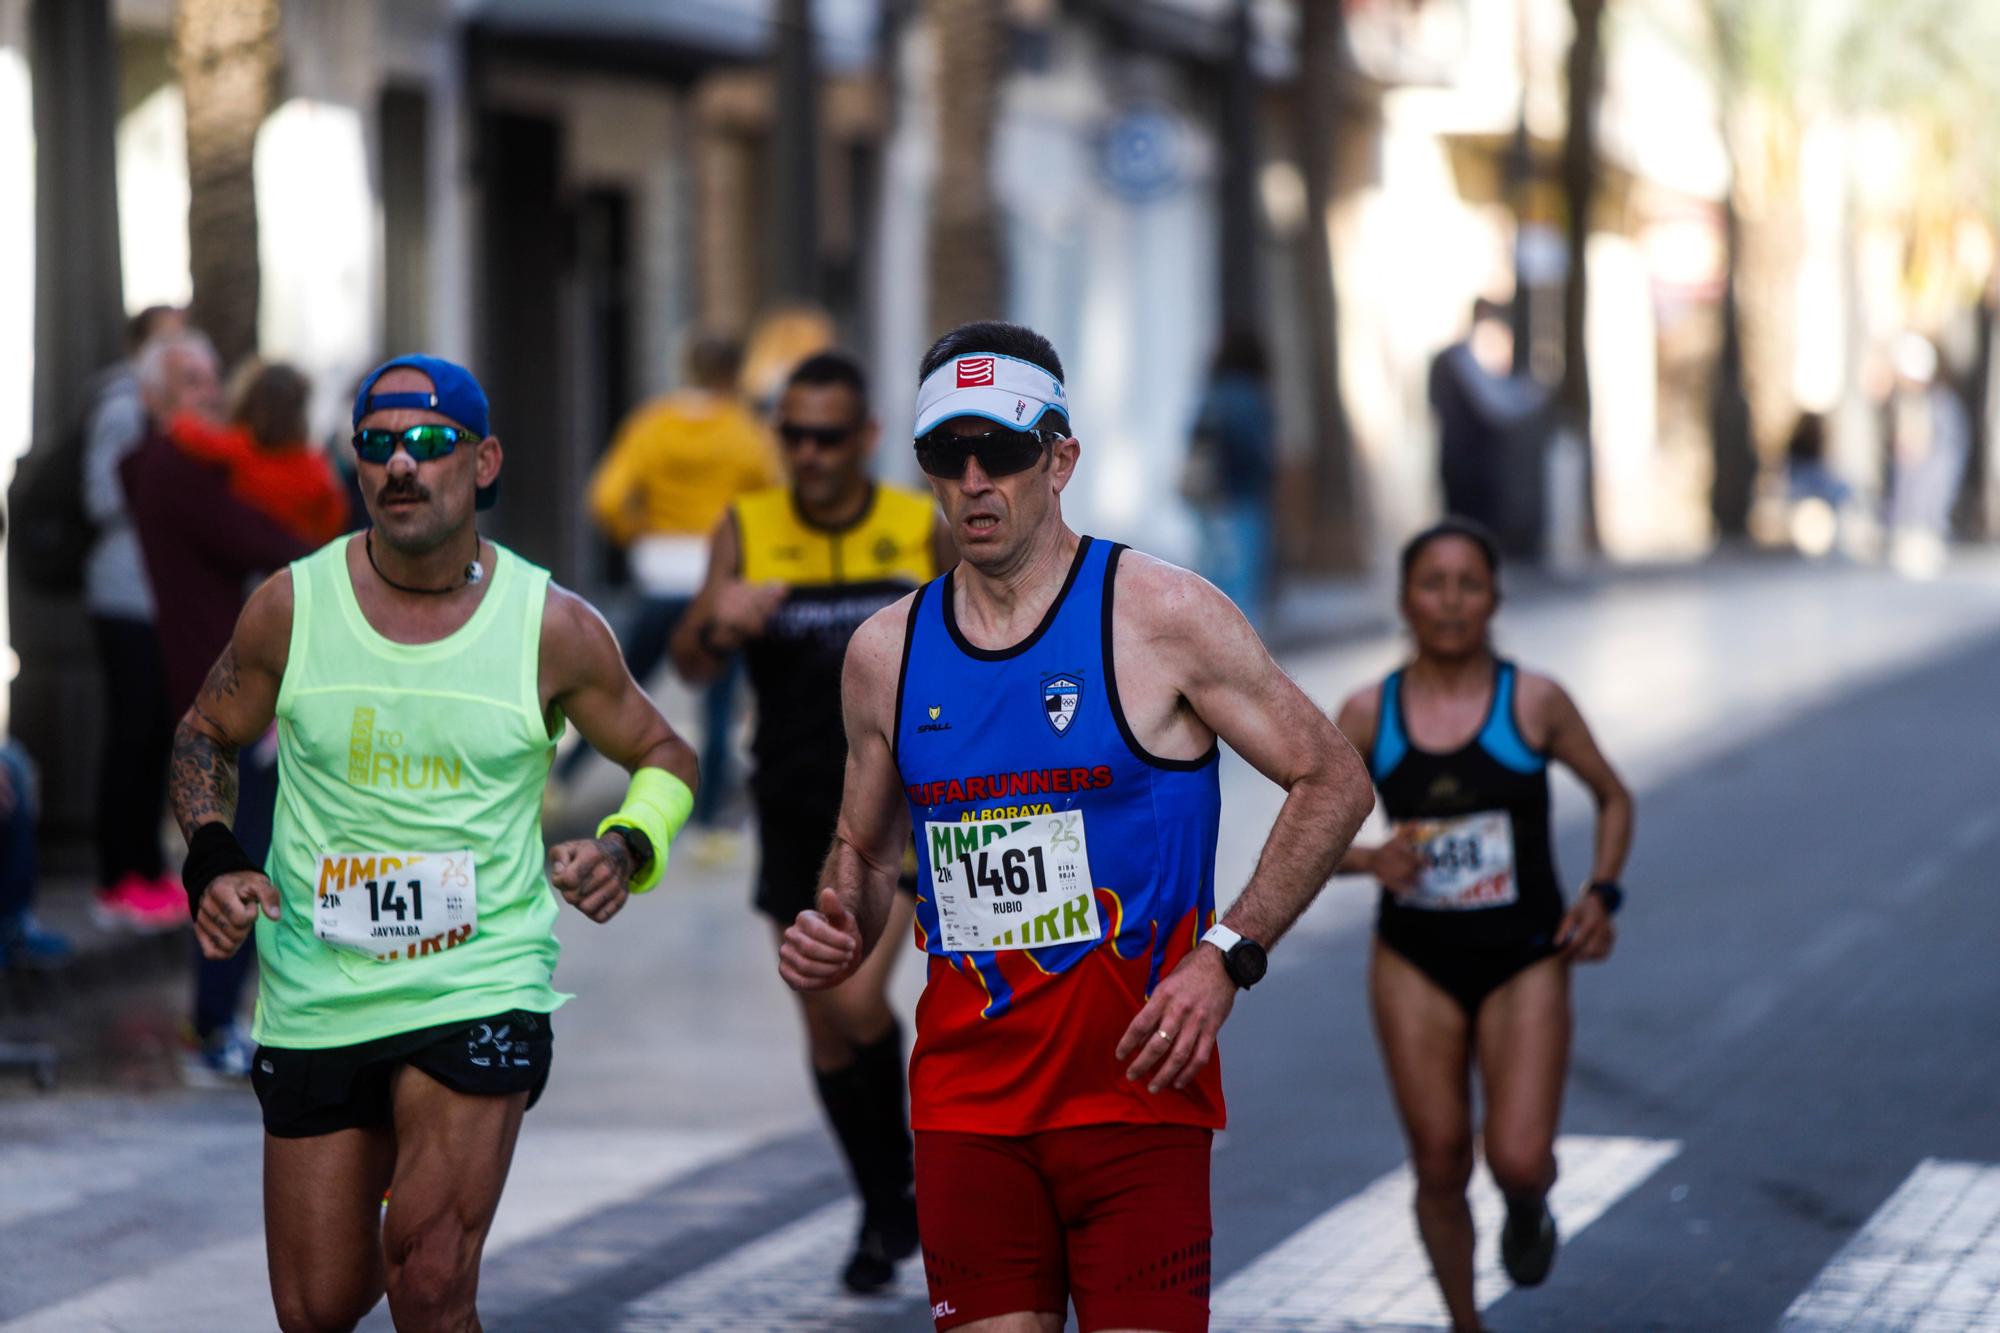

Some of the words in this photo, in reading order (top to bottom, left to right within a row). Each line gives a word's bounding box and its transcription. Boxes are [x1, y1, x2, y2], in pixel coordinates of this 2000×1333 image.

[379, 729, 404, 748] TO
[372, 752, 461, 790] RUN
[960, 803, 1055, 823] ALBORAYA
[959, 846, 1048, 899] 1461
[365, 879, 423, 922] 141
[993, 901, 1022, 914] RUBIO
[370, 925, 420, 938] JAVYALBA
